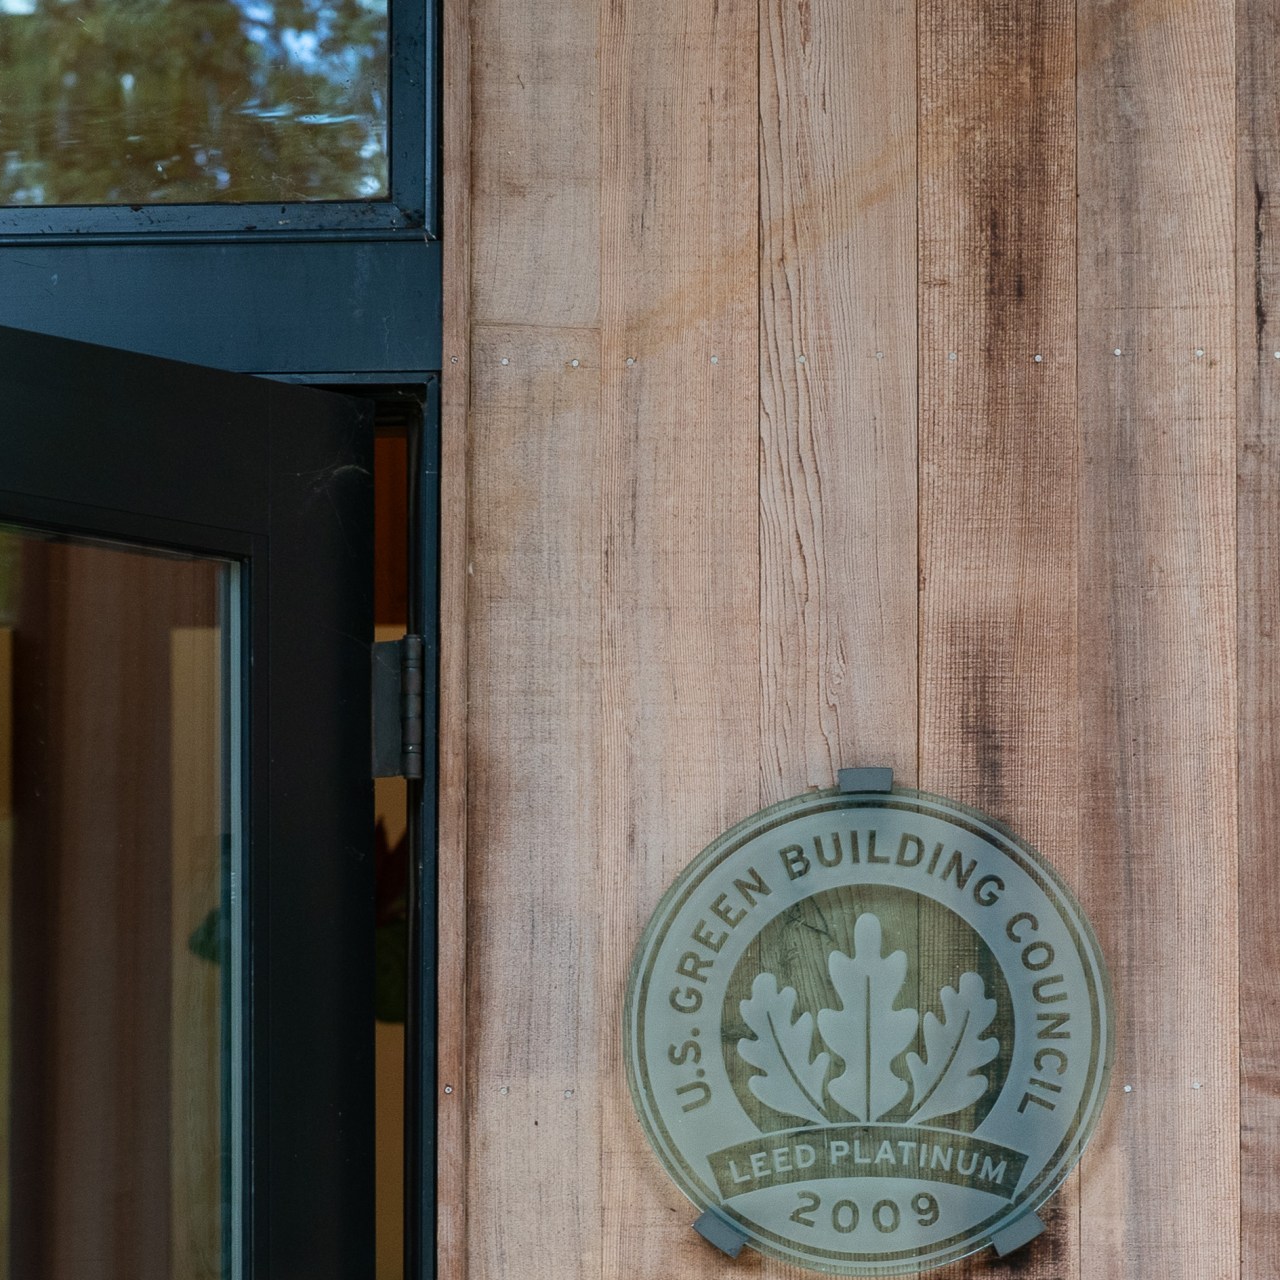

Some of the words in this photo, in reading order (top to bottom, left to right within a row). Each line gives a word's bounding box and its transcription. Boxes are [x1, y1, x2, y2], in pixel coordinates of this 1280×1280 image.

[778, 828, 1007, 909] BUILDING
[668, 866, 772, 1017] GREEN
[1004, 910, 1072, 1118] COUNCIL
[667, 1025, 713, 1115] U.S.
[728, 1143, 817, 1185] LEED
[829, 1139, 1009, 1185] PLATINUM
[788, 1190, 941, 1235] 2009
